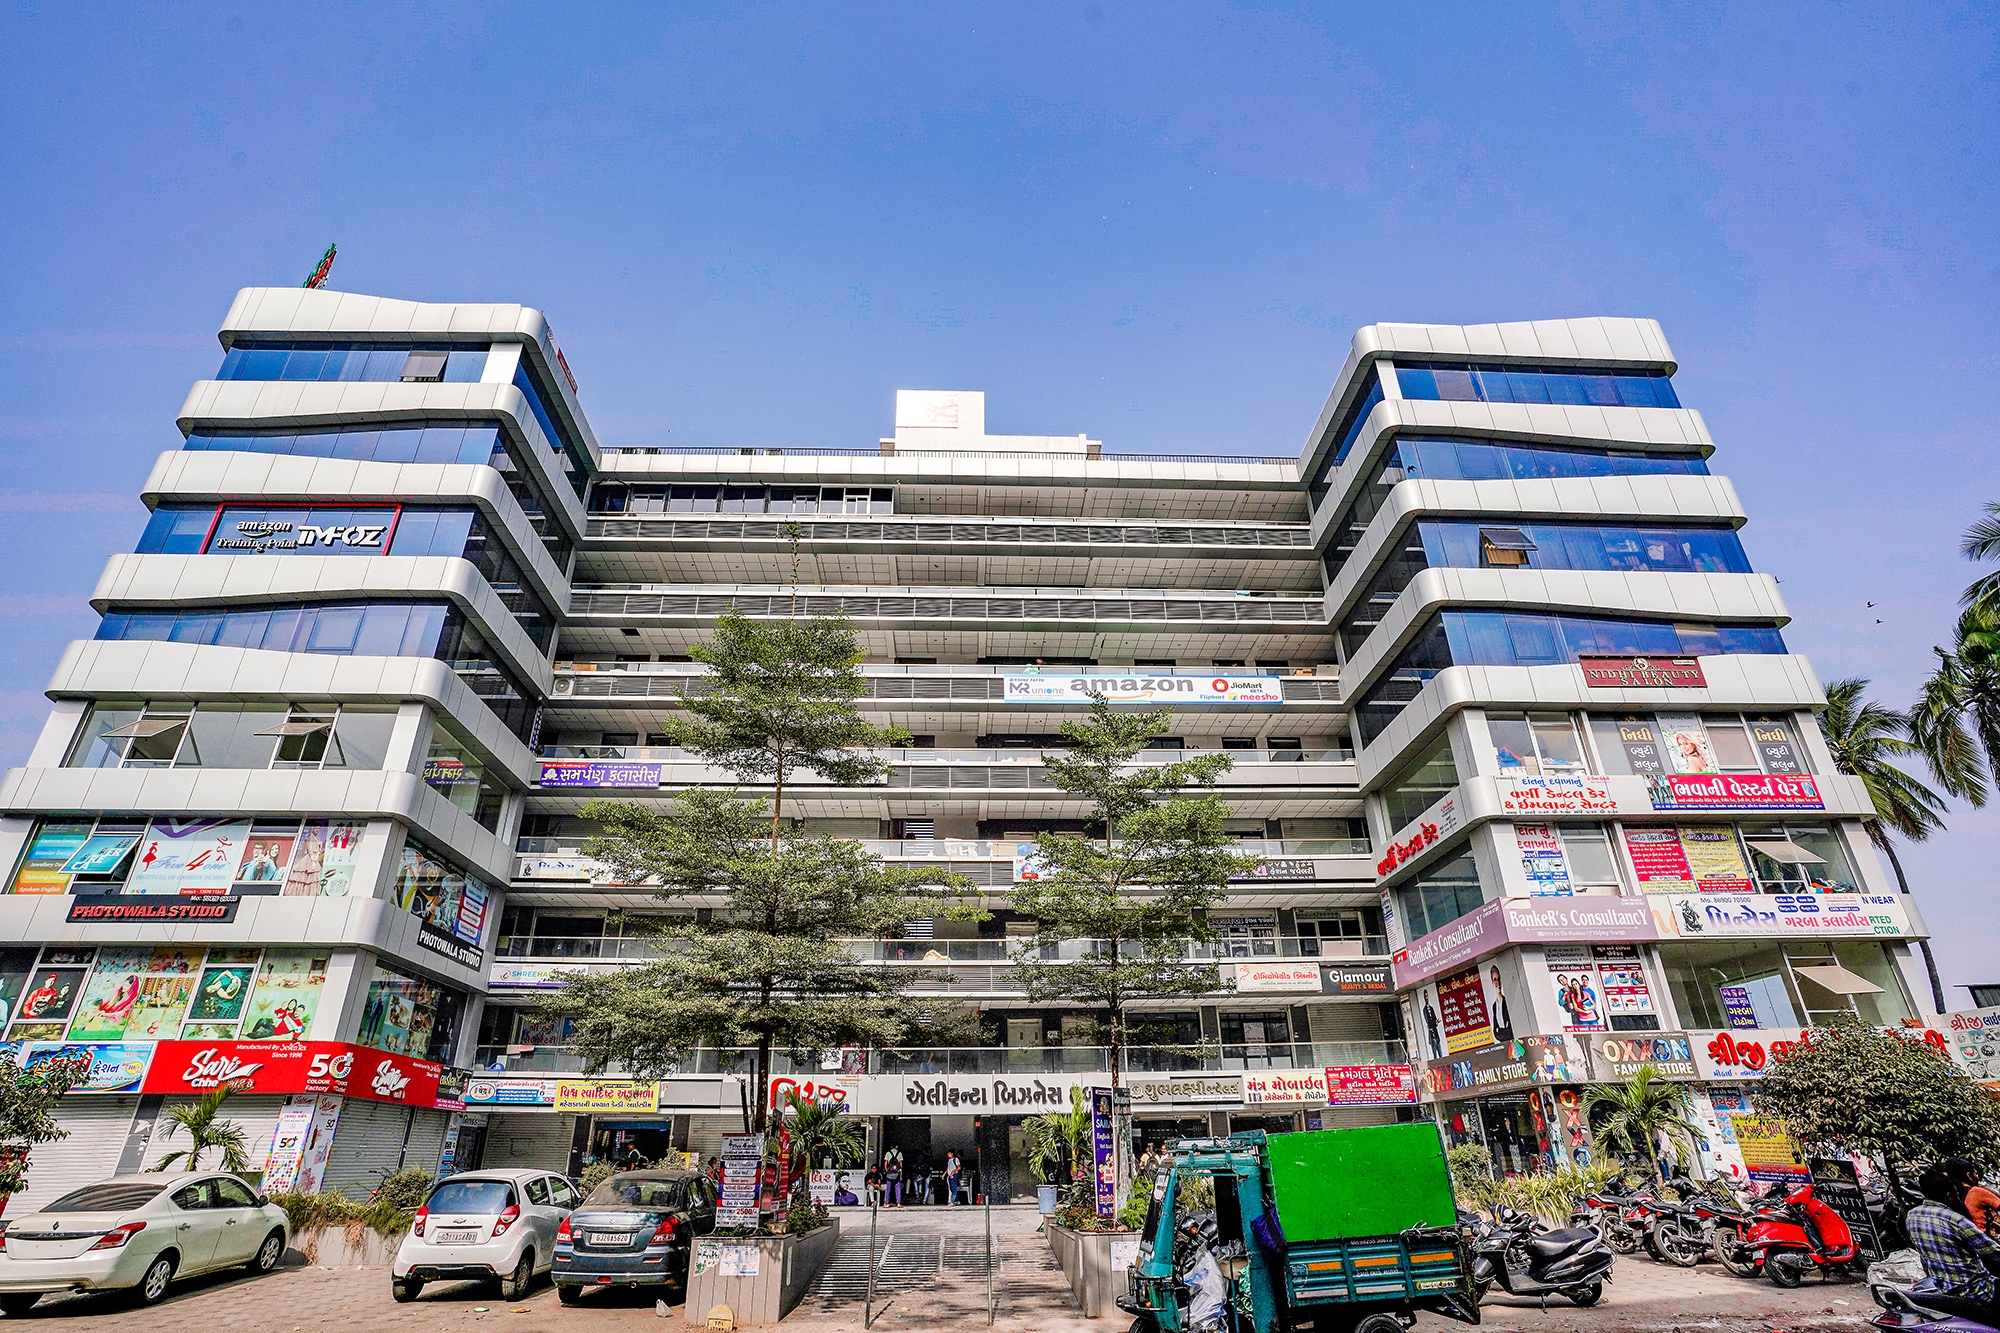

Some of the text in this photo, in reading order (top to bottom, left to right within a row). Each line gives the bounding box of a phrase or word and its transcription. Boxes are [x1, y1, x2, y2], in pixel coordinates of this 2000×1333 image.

[236, 521, 290, 531] amazon
[217, 538, 298, 551] Training Point
[1588, 670, 1699, 678] NIDHI BEAUTY
[1070, 678, 1194, 692] amazon
[1621, 678, 1673, 686] SALON
[560, 764, 606, 784] સમર્પણ
[1674, 778, 1727, 797] ભવાની
[1775, 777, 1801, 796] વેર
[1505, 801, 1515, 809] &
[150, 856, 184, 870] Five
[1871, 896, 1895, 904] WEAR
[72, 905, 227, 918] PHOTOWALA STUDIO
[1509, 908, 1648, 927] BankeR's ConsultancY
[1785, 916, 1818, 928] ગરબા
[420, 930, 480, 968] PHOTOWALA STUDIO
[1408, 940, 1438, 967] BankeR's
[1329, 970, 1385, 983] Glamour
[1951, 1014, 1984, 1031] શ્રીજી
[1528, 1036, 1563, 1046] OXXON
[1603, 1039, 1692, 1063] OXXON
[1708, 1032, 1767, 1069] શ્રીજી
[183, 1048, 243, 1081] Sari
[1658, 1063, 1695, 1075] STORE
[191, 1078, 219, 1088] Chhe
[1247, 1077, 1266, 1091] મંત્ર
[1425, 1060, 1475, 1094] OXXON
[1474, 1066, 1502, 1085] FAMILY
[1503, 1062, 1529, 1081] STORE
[993, 1080, 1063, 1105] બિઝનેસ
[1821, 1194, 1862, 1207] BEAUTY
